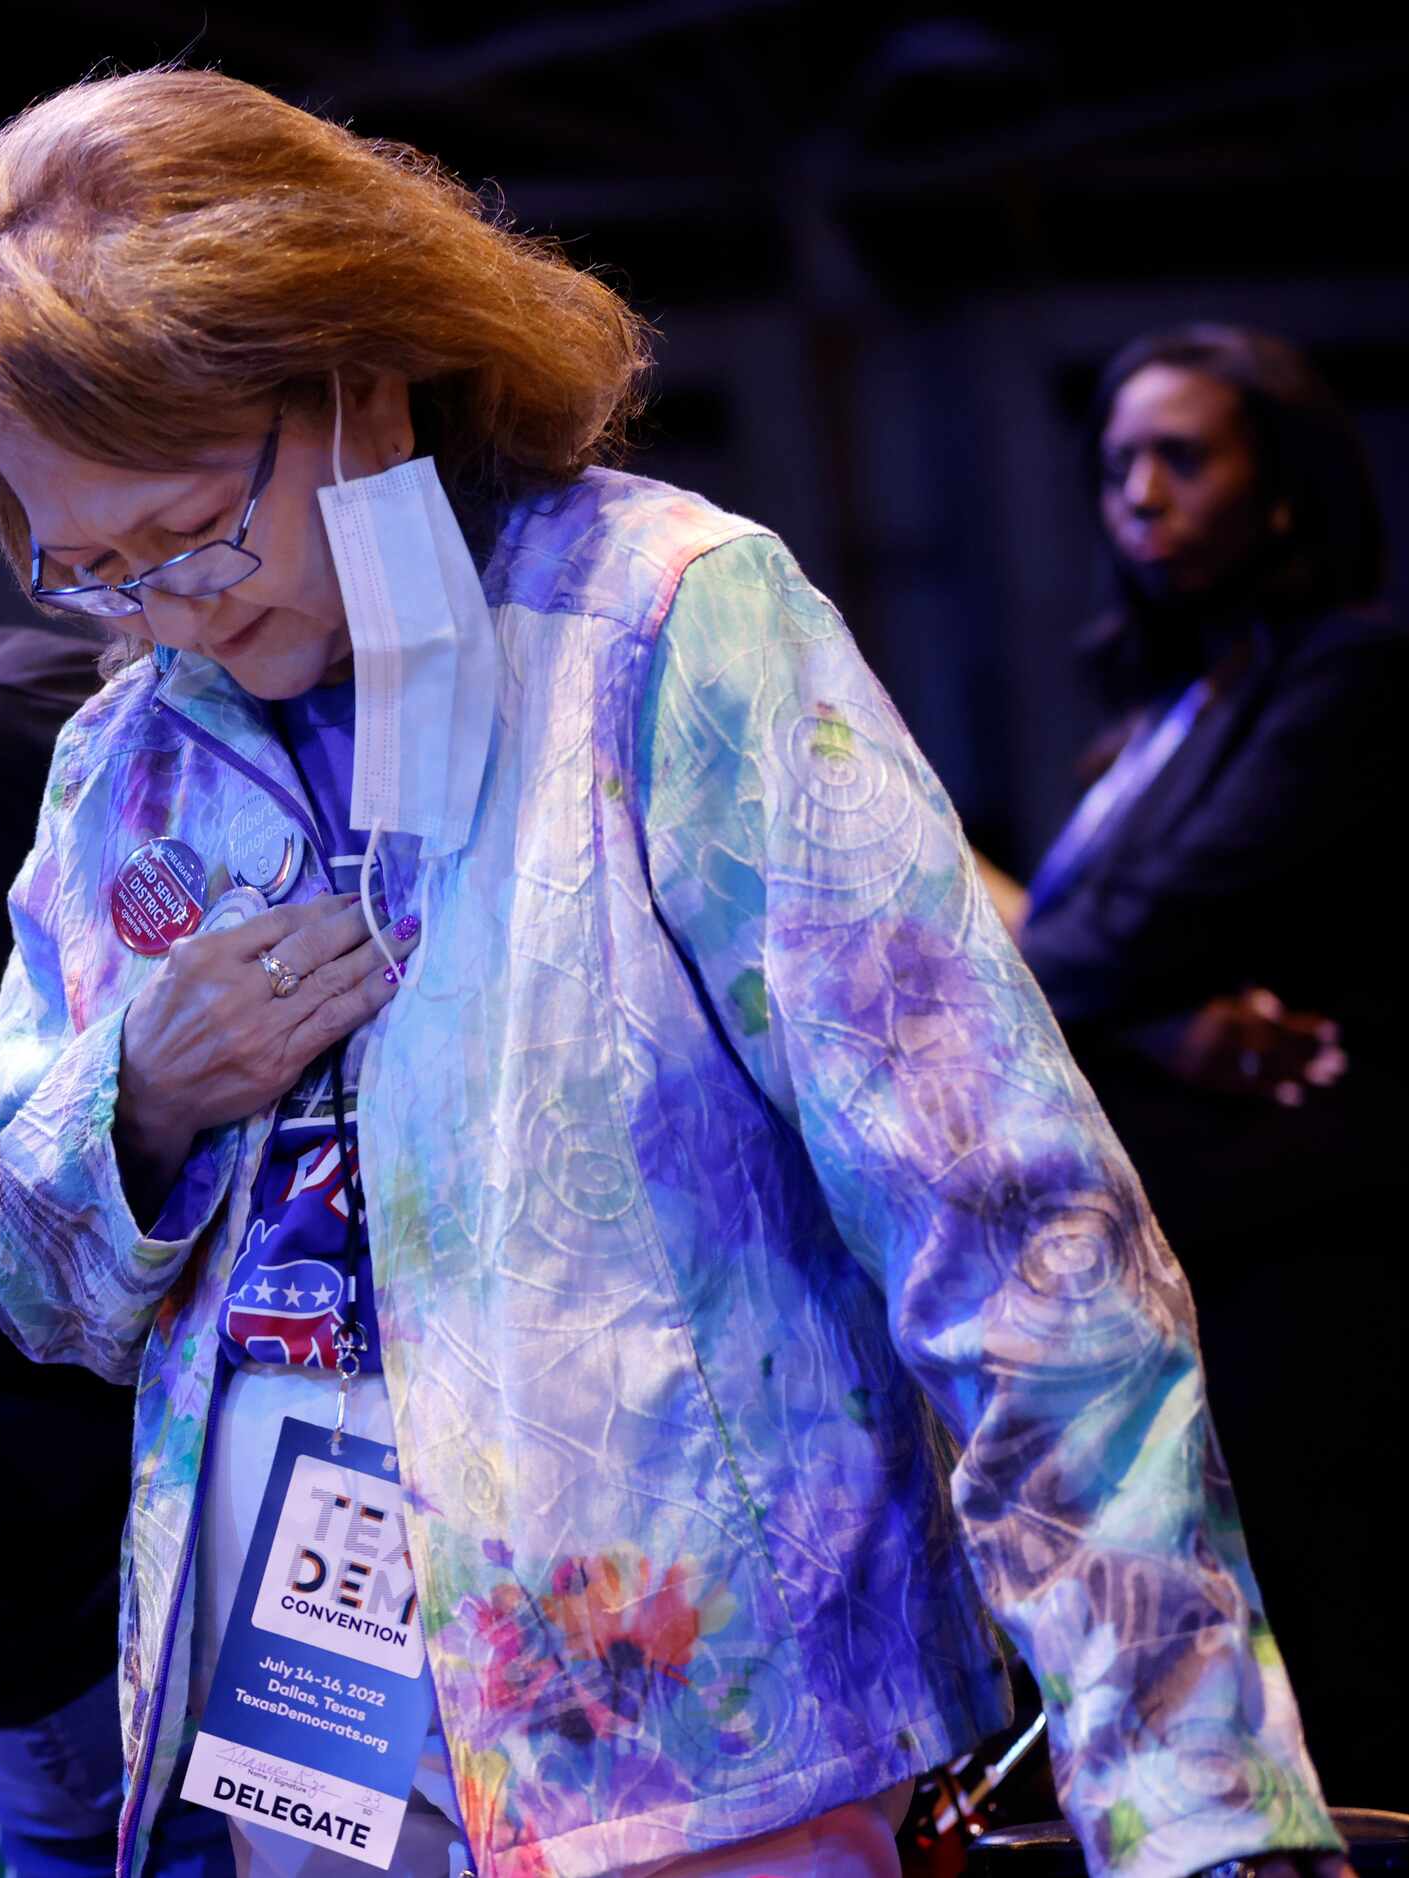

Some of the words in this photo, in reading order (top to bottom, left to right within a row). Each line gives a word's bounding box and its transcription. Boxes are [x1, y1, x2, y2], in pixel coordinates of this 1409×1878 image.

[135, 855, 158, 883] 23RD
[154, 880, 189, 926] SENATE
[167, 850, 194, 885] DELEGATE
[129, 877, 169, 930] DISTRICT
[286, 1544, 417, 1625] DEM
[281, 1596, 407, 1647] CONVENTION
[259, 1656, 292, 1678] July
[294, 1667, 343, 1694] 14-16,
[347, 1684, 386, 1707] 2022
[267, 1678, 319, 1707] Dallas,
[323, 1696, 366, 1721] Texas
[235, 1688, 389, 1753] TexasDemocrats.org
[248, 1768, 268, 1780] Name
[274, 1776, 307, 1793] Signature
[213, 1776, 371, 1849] DELEGATE
